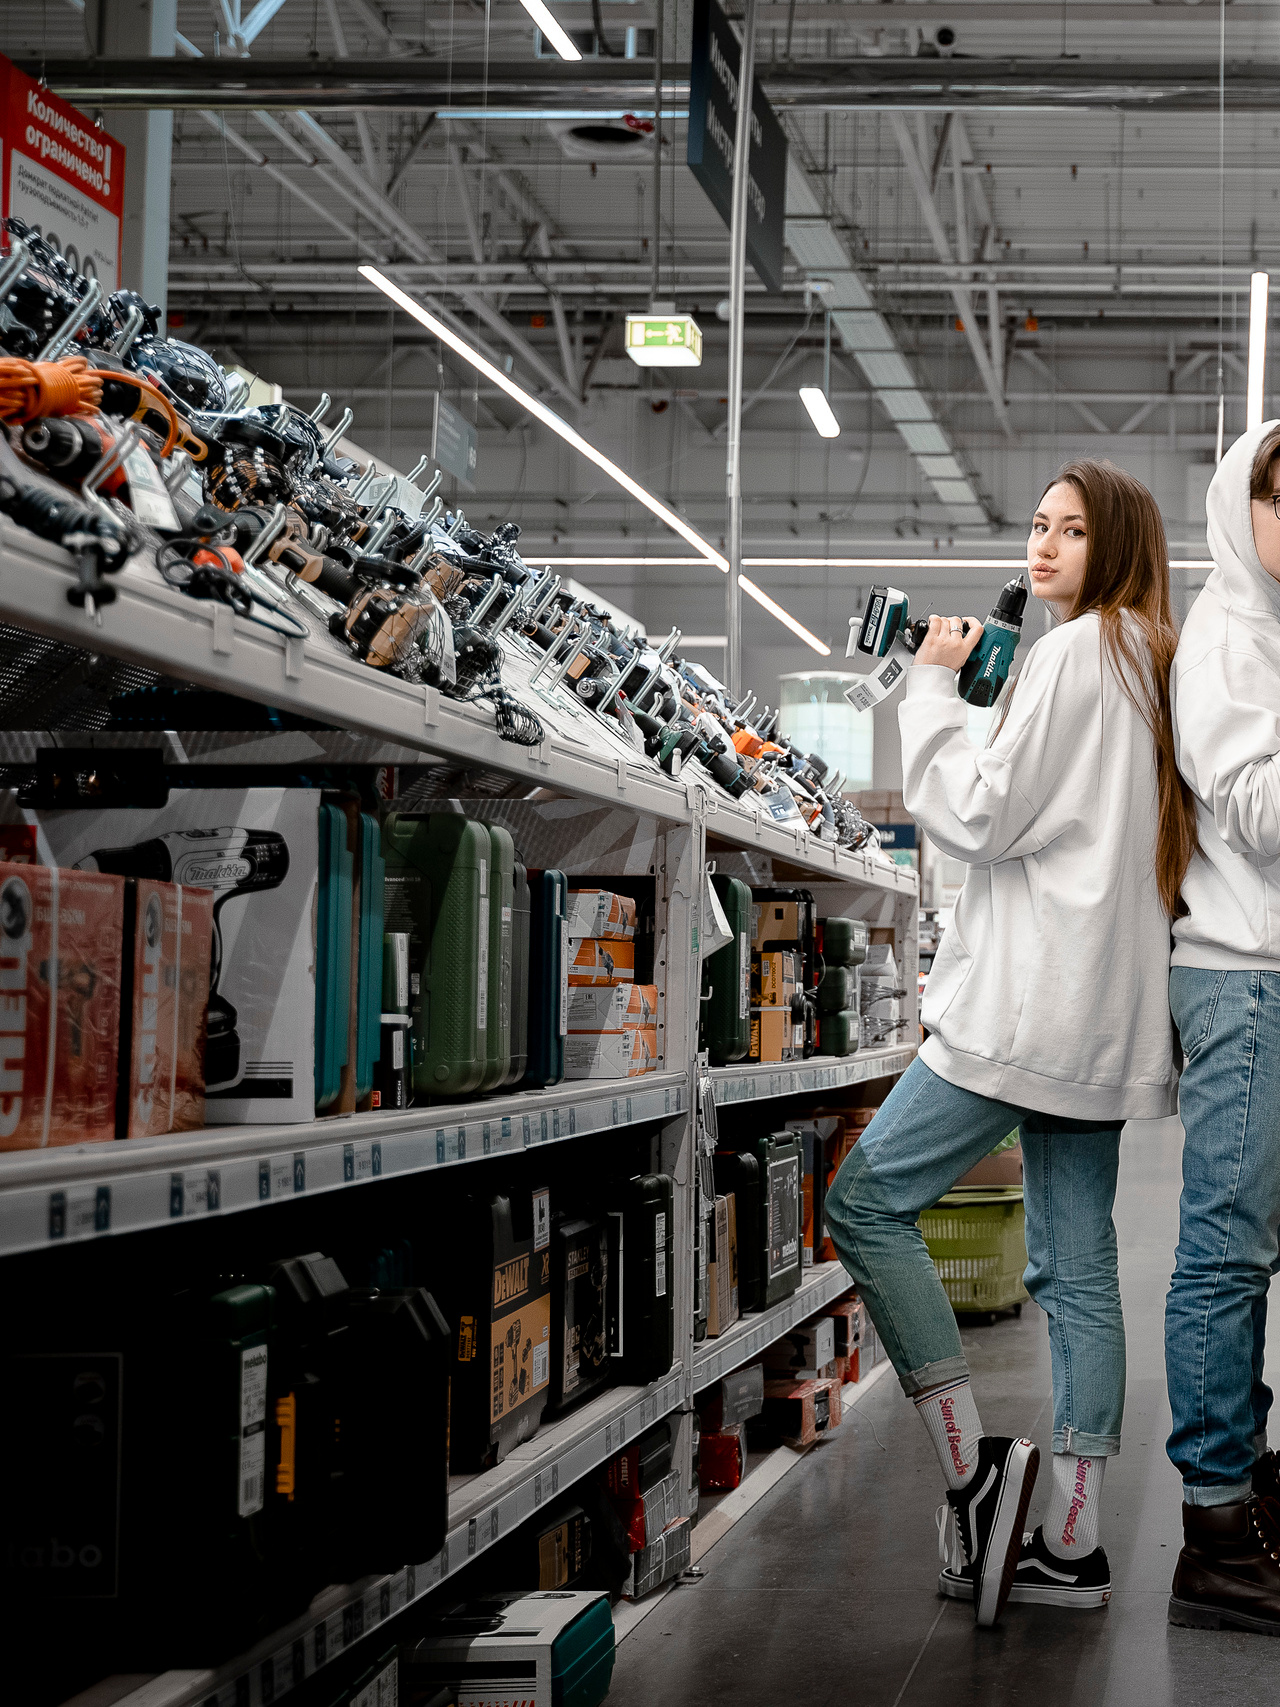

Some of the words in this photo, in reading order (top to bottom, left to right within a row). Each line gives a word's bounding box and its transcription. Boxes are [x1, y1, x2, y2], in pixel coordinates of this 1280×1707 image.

[27, 89, 104, 163] Количество
[884, 671, 895, 684] 11
[568, 1246, 590, 1267] STANLEY
[939, 1397, 955, 1421] Sun
[945, 1421, 962, 1436] of
[947, 1434, 970, 1477] Beach
[1075, 1456, 1092, 1481] Sun
[1074, 1482, 1087, 1501] of
[1061, 1496, 1085, 1547] Beach
[6, 1536, 104, 1569] tabo
